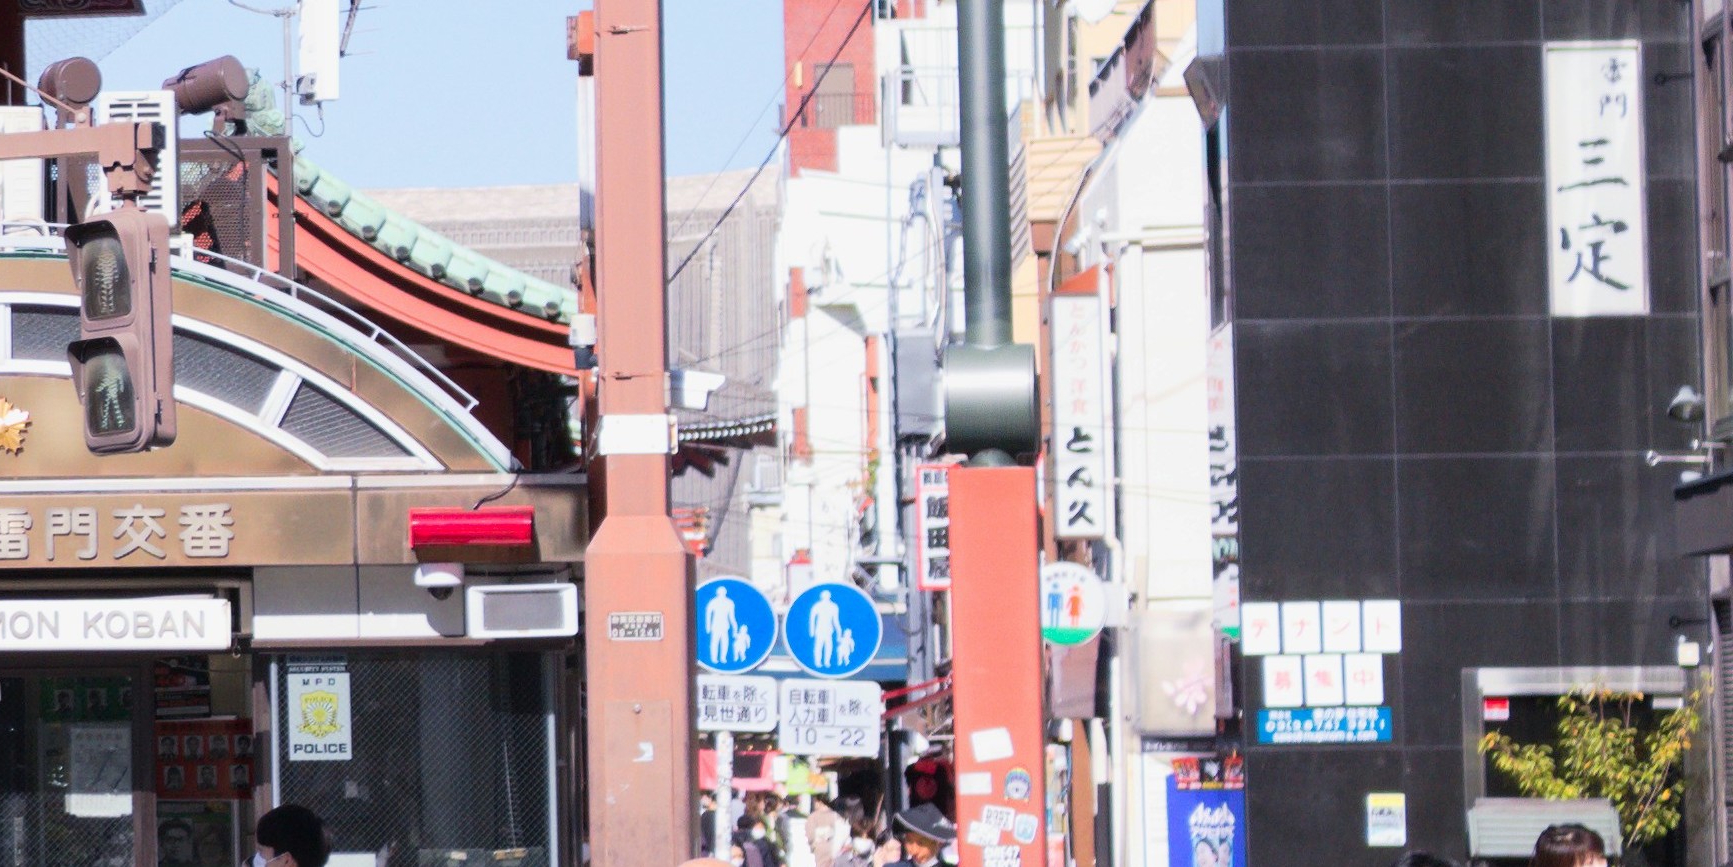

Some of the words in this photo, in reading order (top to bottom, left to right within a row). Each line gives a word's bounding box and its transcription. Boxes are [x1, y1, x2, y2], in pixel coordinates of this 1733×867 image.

[1557, 138, 1633, 291] 三定
[1067, 426, 1095, 527] とん久
[82, 608, 206, 640] KOBAN
[789, 688, 830, 705] 自転車
[789, 707, 830, 724] 人力車
[293, 743, 348, 754] POLICE
